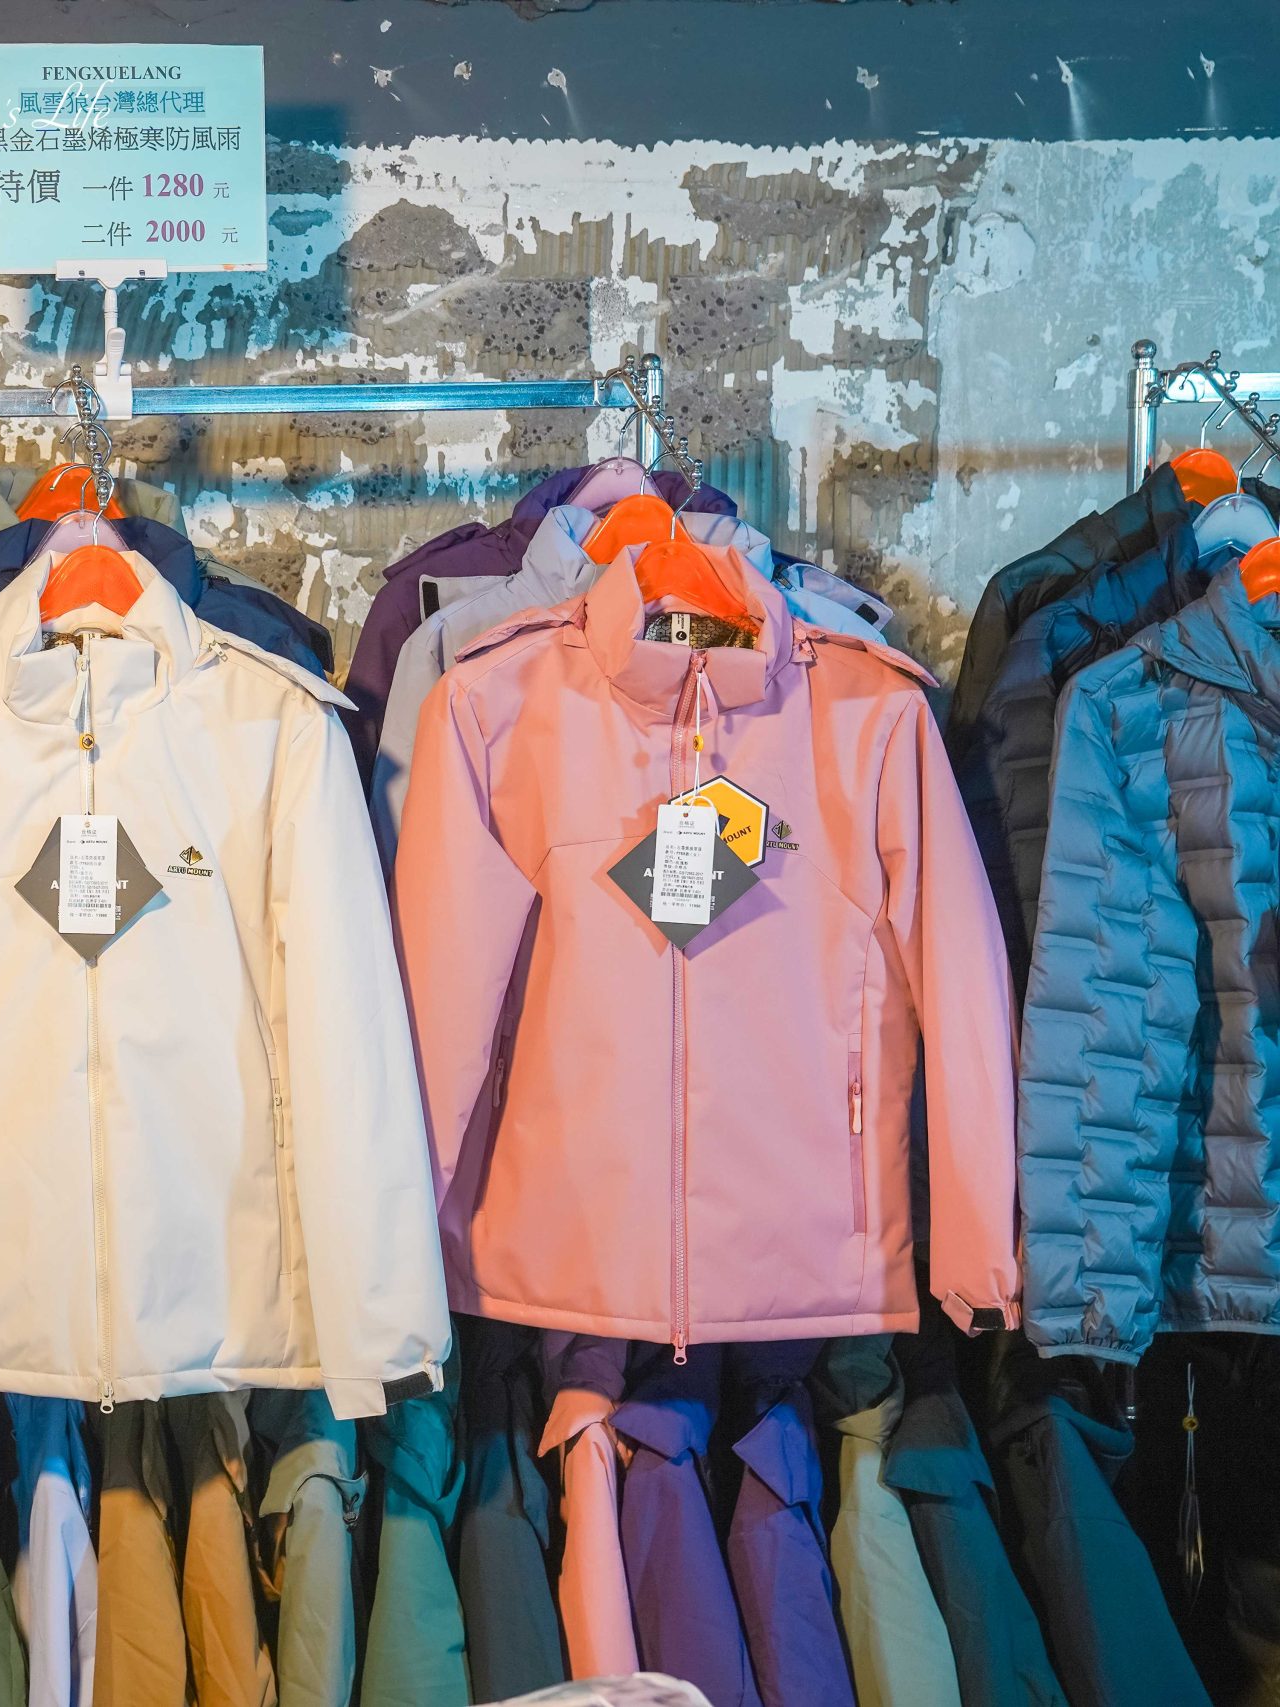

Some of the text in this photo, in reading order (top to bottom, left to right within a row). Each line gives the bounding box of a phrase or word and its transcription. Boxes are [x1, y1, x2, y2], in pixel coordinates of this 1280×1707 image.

[41, 65, 182, 81] FENGXUELANG
[19, 90, 206, 115] 風雪狼台灣總代理
[82, 175, 134, 201] 一件
[141, 173, 205, 198] 1280
[213, 182, 230, 199] 元
[81, 219, 239, 247] 二件 2000 元
[186, 867, 214, 878] MOUNT
